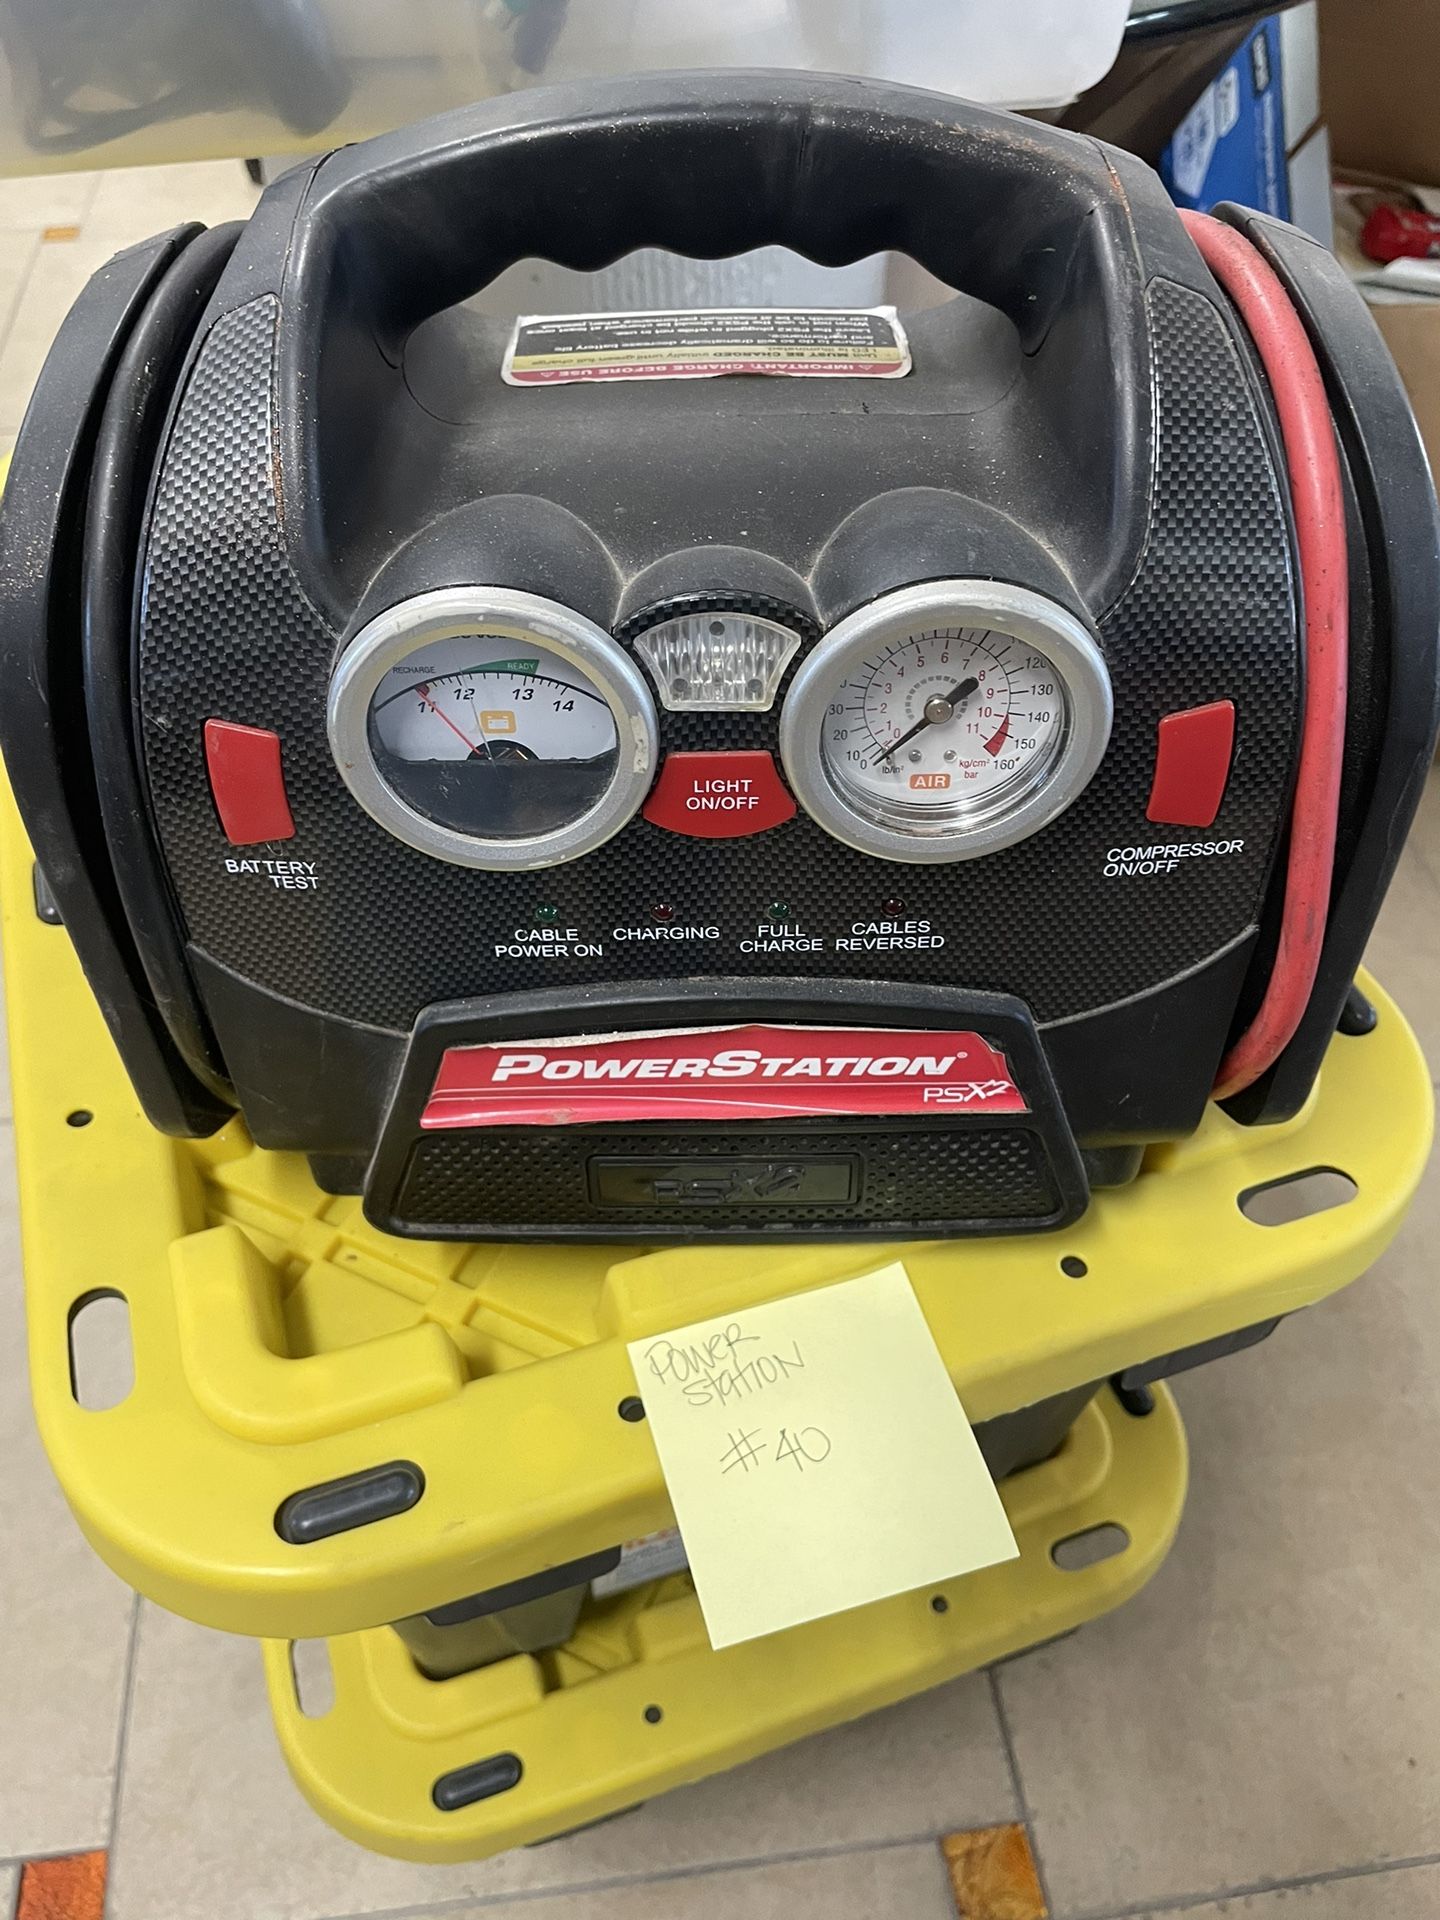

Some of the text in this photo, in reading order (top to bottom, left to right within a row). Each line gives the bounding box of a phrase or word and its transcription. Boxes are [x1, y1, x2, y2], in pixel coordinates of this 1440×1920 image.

[598, 365, 667, 375] BEFORE
[673, 363, 744, 371] CHARGE
[751, 363, 854, 371] IMPORTANT:
[917, 656, 925, 668] 5
[941, 652, 949, 663] 6
[392, 666, 436, 674] RECHARGE
[507, 661, 536, 671] READY
[963, 659, 971, 671] 7
[897, 666, 905, 677] 4
[978, 670, 987, 681] 8
[453, 688, 476, 700] 12
[512, 688, 535, 701] 13
[884, 683, 893, 694] 3
[986, 688, 995, 699] 9
[1030, 684, 1054, 696] 130
[552, 700, 575, 713] 14
[829, 704, 844, 715] 30
[880, 703, 888, 714] 2
[978, 707, 993, 718] 10
[1028, 711, 1050, 723] 140
[886, 720, 892, 731] 1
[967, 723, 980, 734] 11
[833, 729, 848, 741] 20
[893, 728, 902, 739] 0
[1014, 738, 1037, 750] 150
[846, 750, 861, 761] 10
[860, 759, 868, 770] 0
[993, 759, 1015, 770] 160
[913, 774, 948, 788] AIR
[964, 771, 979, 780] bar
[693, 779, 753, 794] LIGHT
[685, 797, 760, 811] ON/OFF
[1106, 839, 1245, 863] COMPRESSOR
[225, 859, 316, 875] BATTERY
[1103, 859, 1180, 878] ON/OFF
[268, 875, 319, 890] TEST
[612, 926, 720, 941] CHARGING
[757, 924, 806, 938] FULL
[851, 920, 931, 936] CABLES
[514, 928, 579, 942] CABLE
[739, 938, 823, 953] CHARGE
[835, 935, 945, 951] REVERSED
[495, 943, 603, 958] POWER ON
[923, 1079, 1013, 1103] PSX2
[719, 1426, 831, 1474] #40
